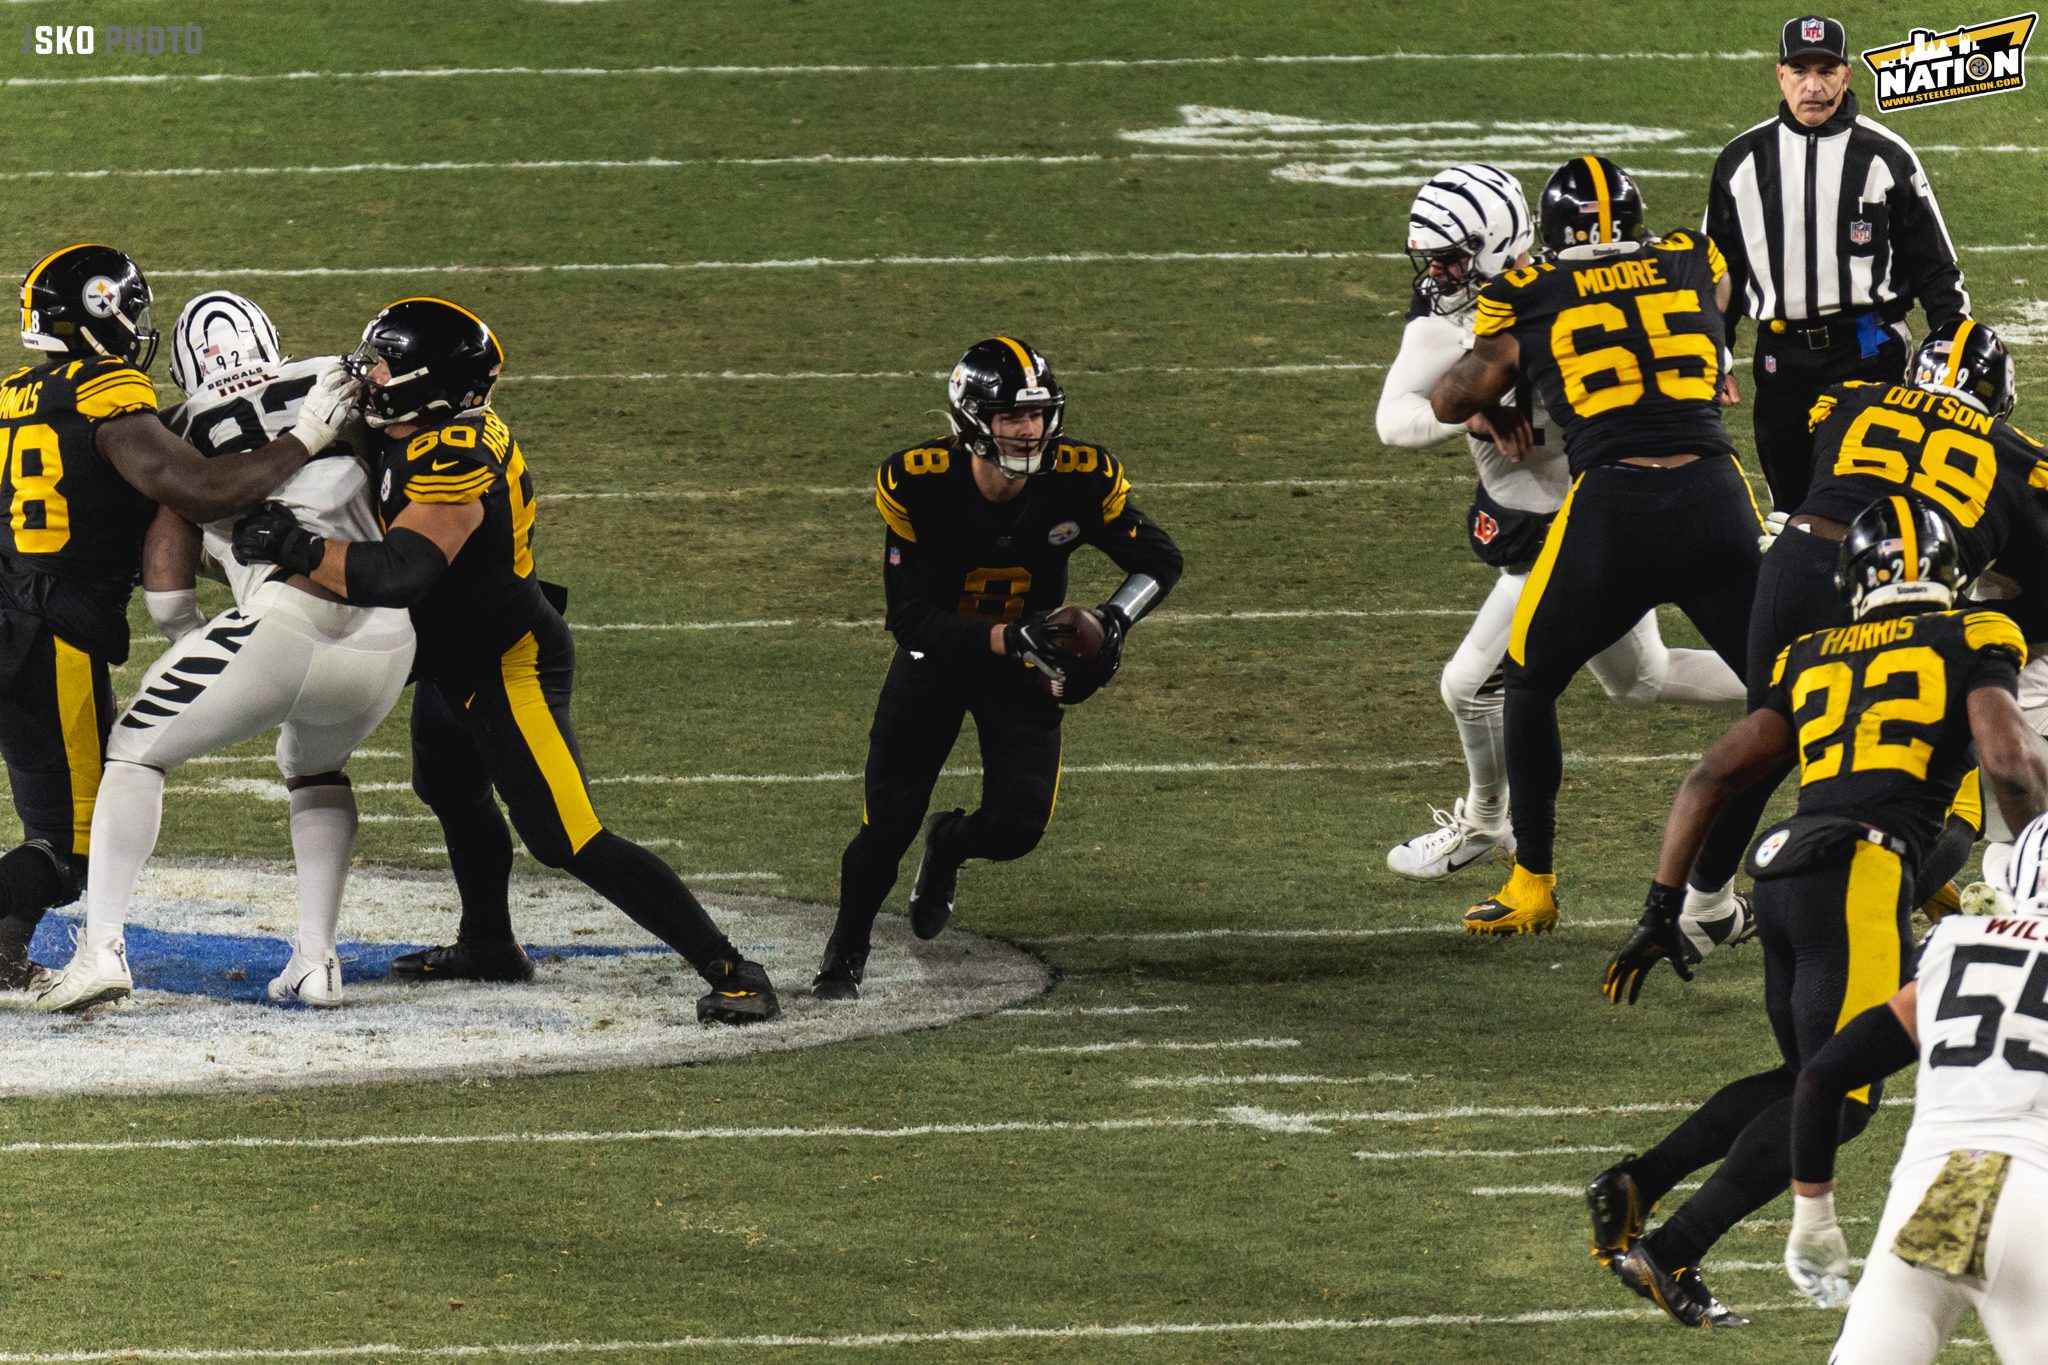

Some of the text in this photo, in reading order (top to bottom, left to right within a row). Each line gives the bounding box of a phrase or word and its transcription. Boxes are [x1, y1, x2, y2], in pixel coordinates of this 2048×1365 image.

[1852, 229, 1870, 240] NFL
[1573, 257, 1668, 298] MOORE
[215, 350, 243, 371] 92
[1550, 289, 1718, 418] 65
[207, 366, 264, 391] BENGALS
[1883, 385, 1995, 435] DOTSON
[406, 425, 477, 462] 60
[904, 447, 949, 476] 8
[1891, 556, 1931, 584] 22
[1820, 615, 1915, 656] HARRIS
[1791, 645, 1947, 788] 22
[1985, 918, 2048, 943] WIL
